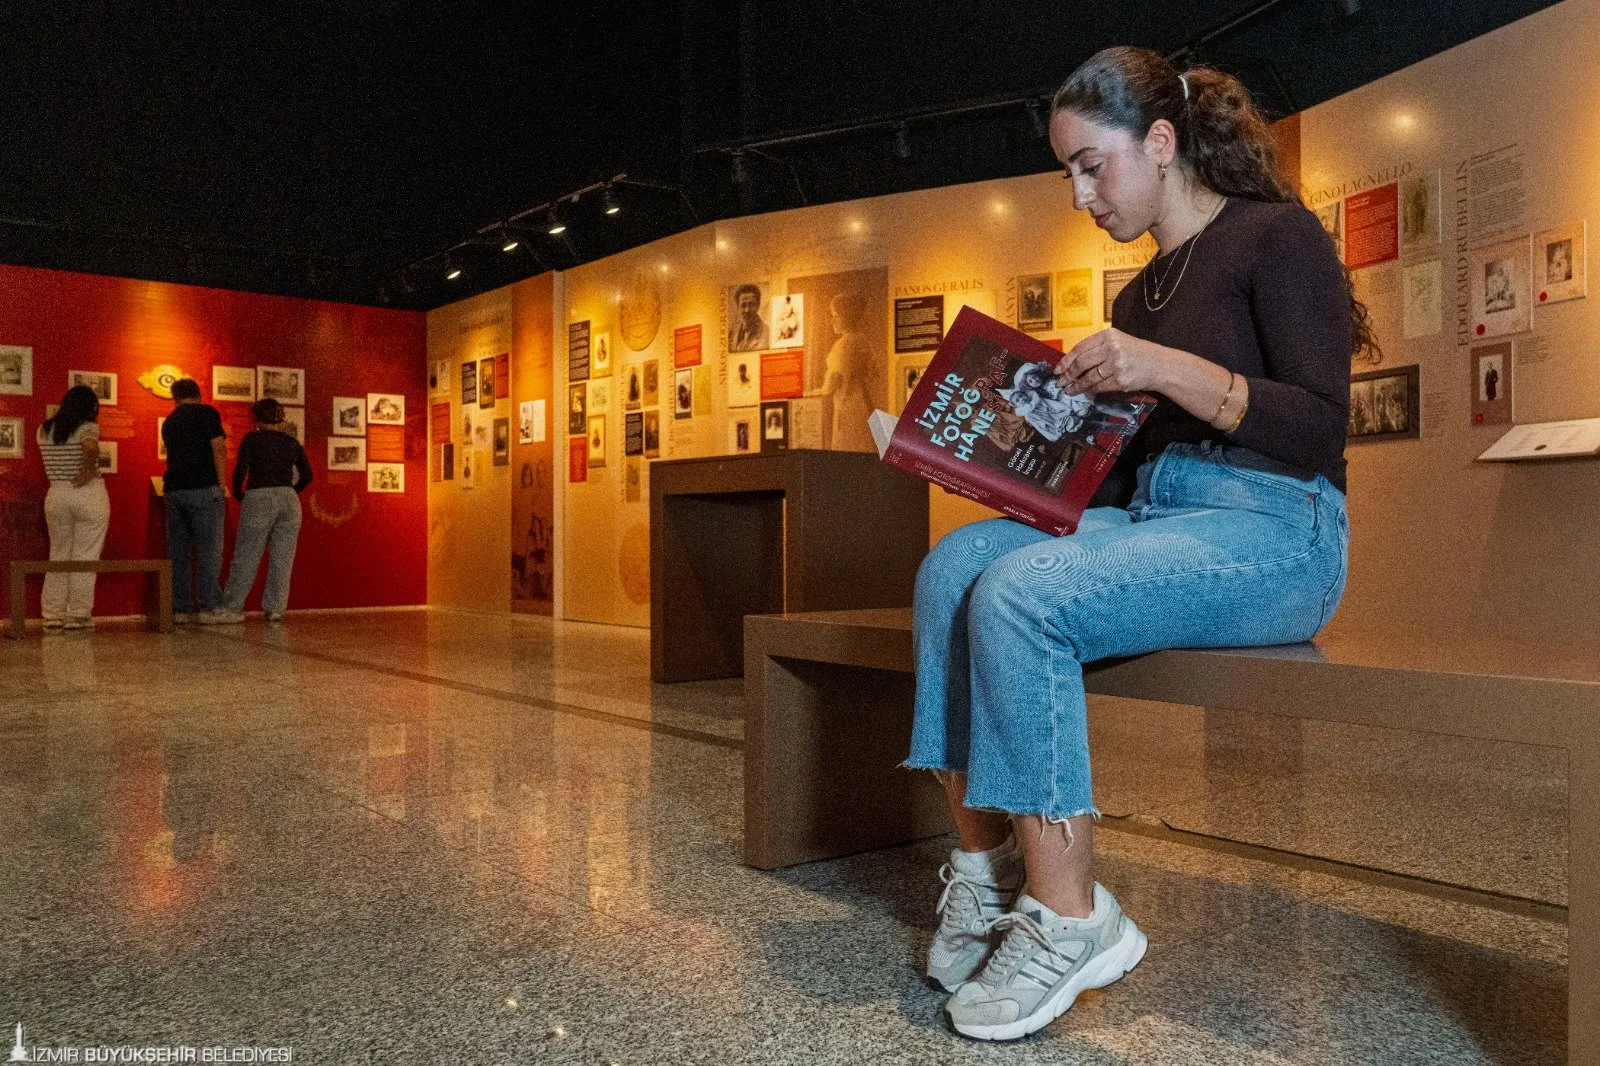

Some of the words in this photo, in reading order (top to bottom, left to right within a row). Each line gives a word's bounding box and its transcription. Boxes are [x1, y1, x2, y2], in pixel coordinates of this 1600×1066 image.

[1456, 159, 1470, 253] RUBELLIN
[1104, 254, 1153, 267] BOUKA
[1456, 257, 1470, 346] EDOUARD
[914, 373, 964, 430] İZMİR
